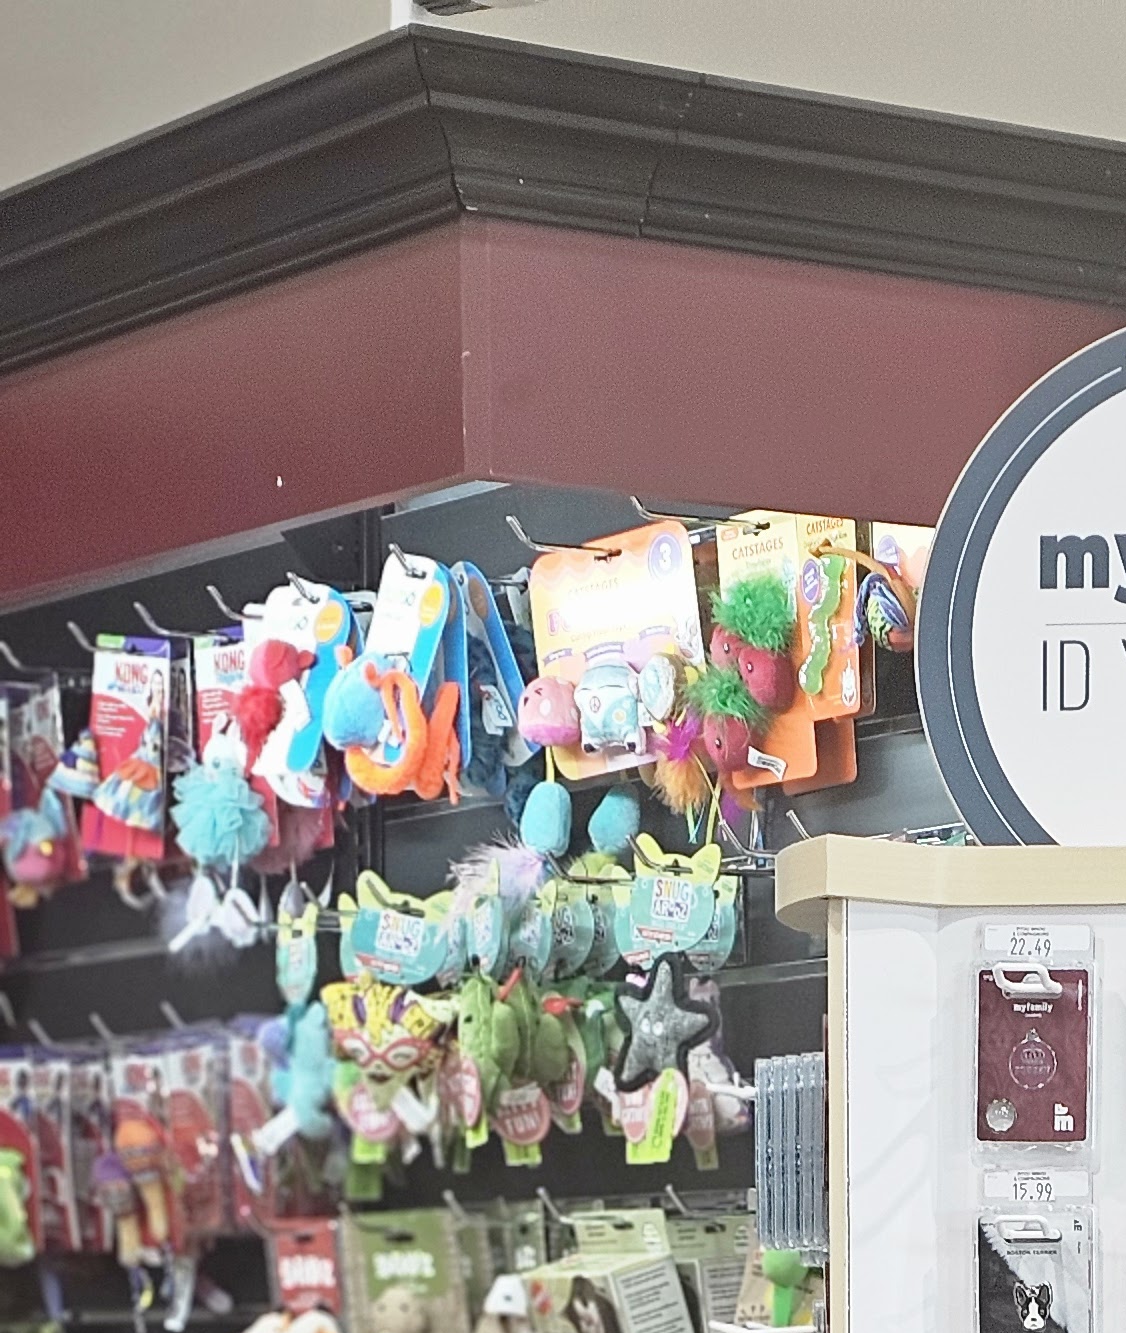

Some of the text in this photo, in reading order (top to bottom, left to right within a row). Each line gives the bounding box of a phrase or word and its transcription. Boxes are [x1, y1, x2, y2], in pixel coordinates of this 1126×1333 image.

[658, 542, 673, 570] 3
[732, 537, 784, 561] CATSTAGES
[214, 650, 246, 673] KONG
[115, 662, 148, 685] KONG
[1042, 639, 1091, 711] ID
[656, 880, 689, 901] SNUG
[1010, 937, 1051, 957] 22.49
[1013, 1001, 1053, 1013] myfamily
[1013, 1183, 1052, 1202] 15.99
